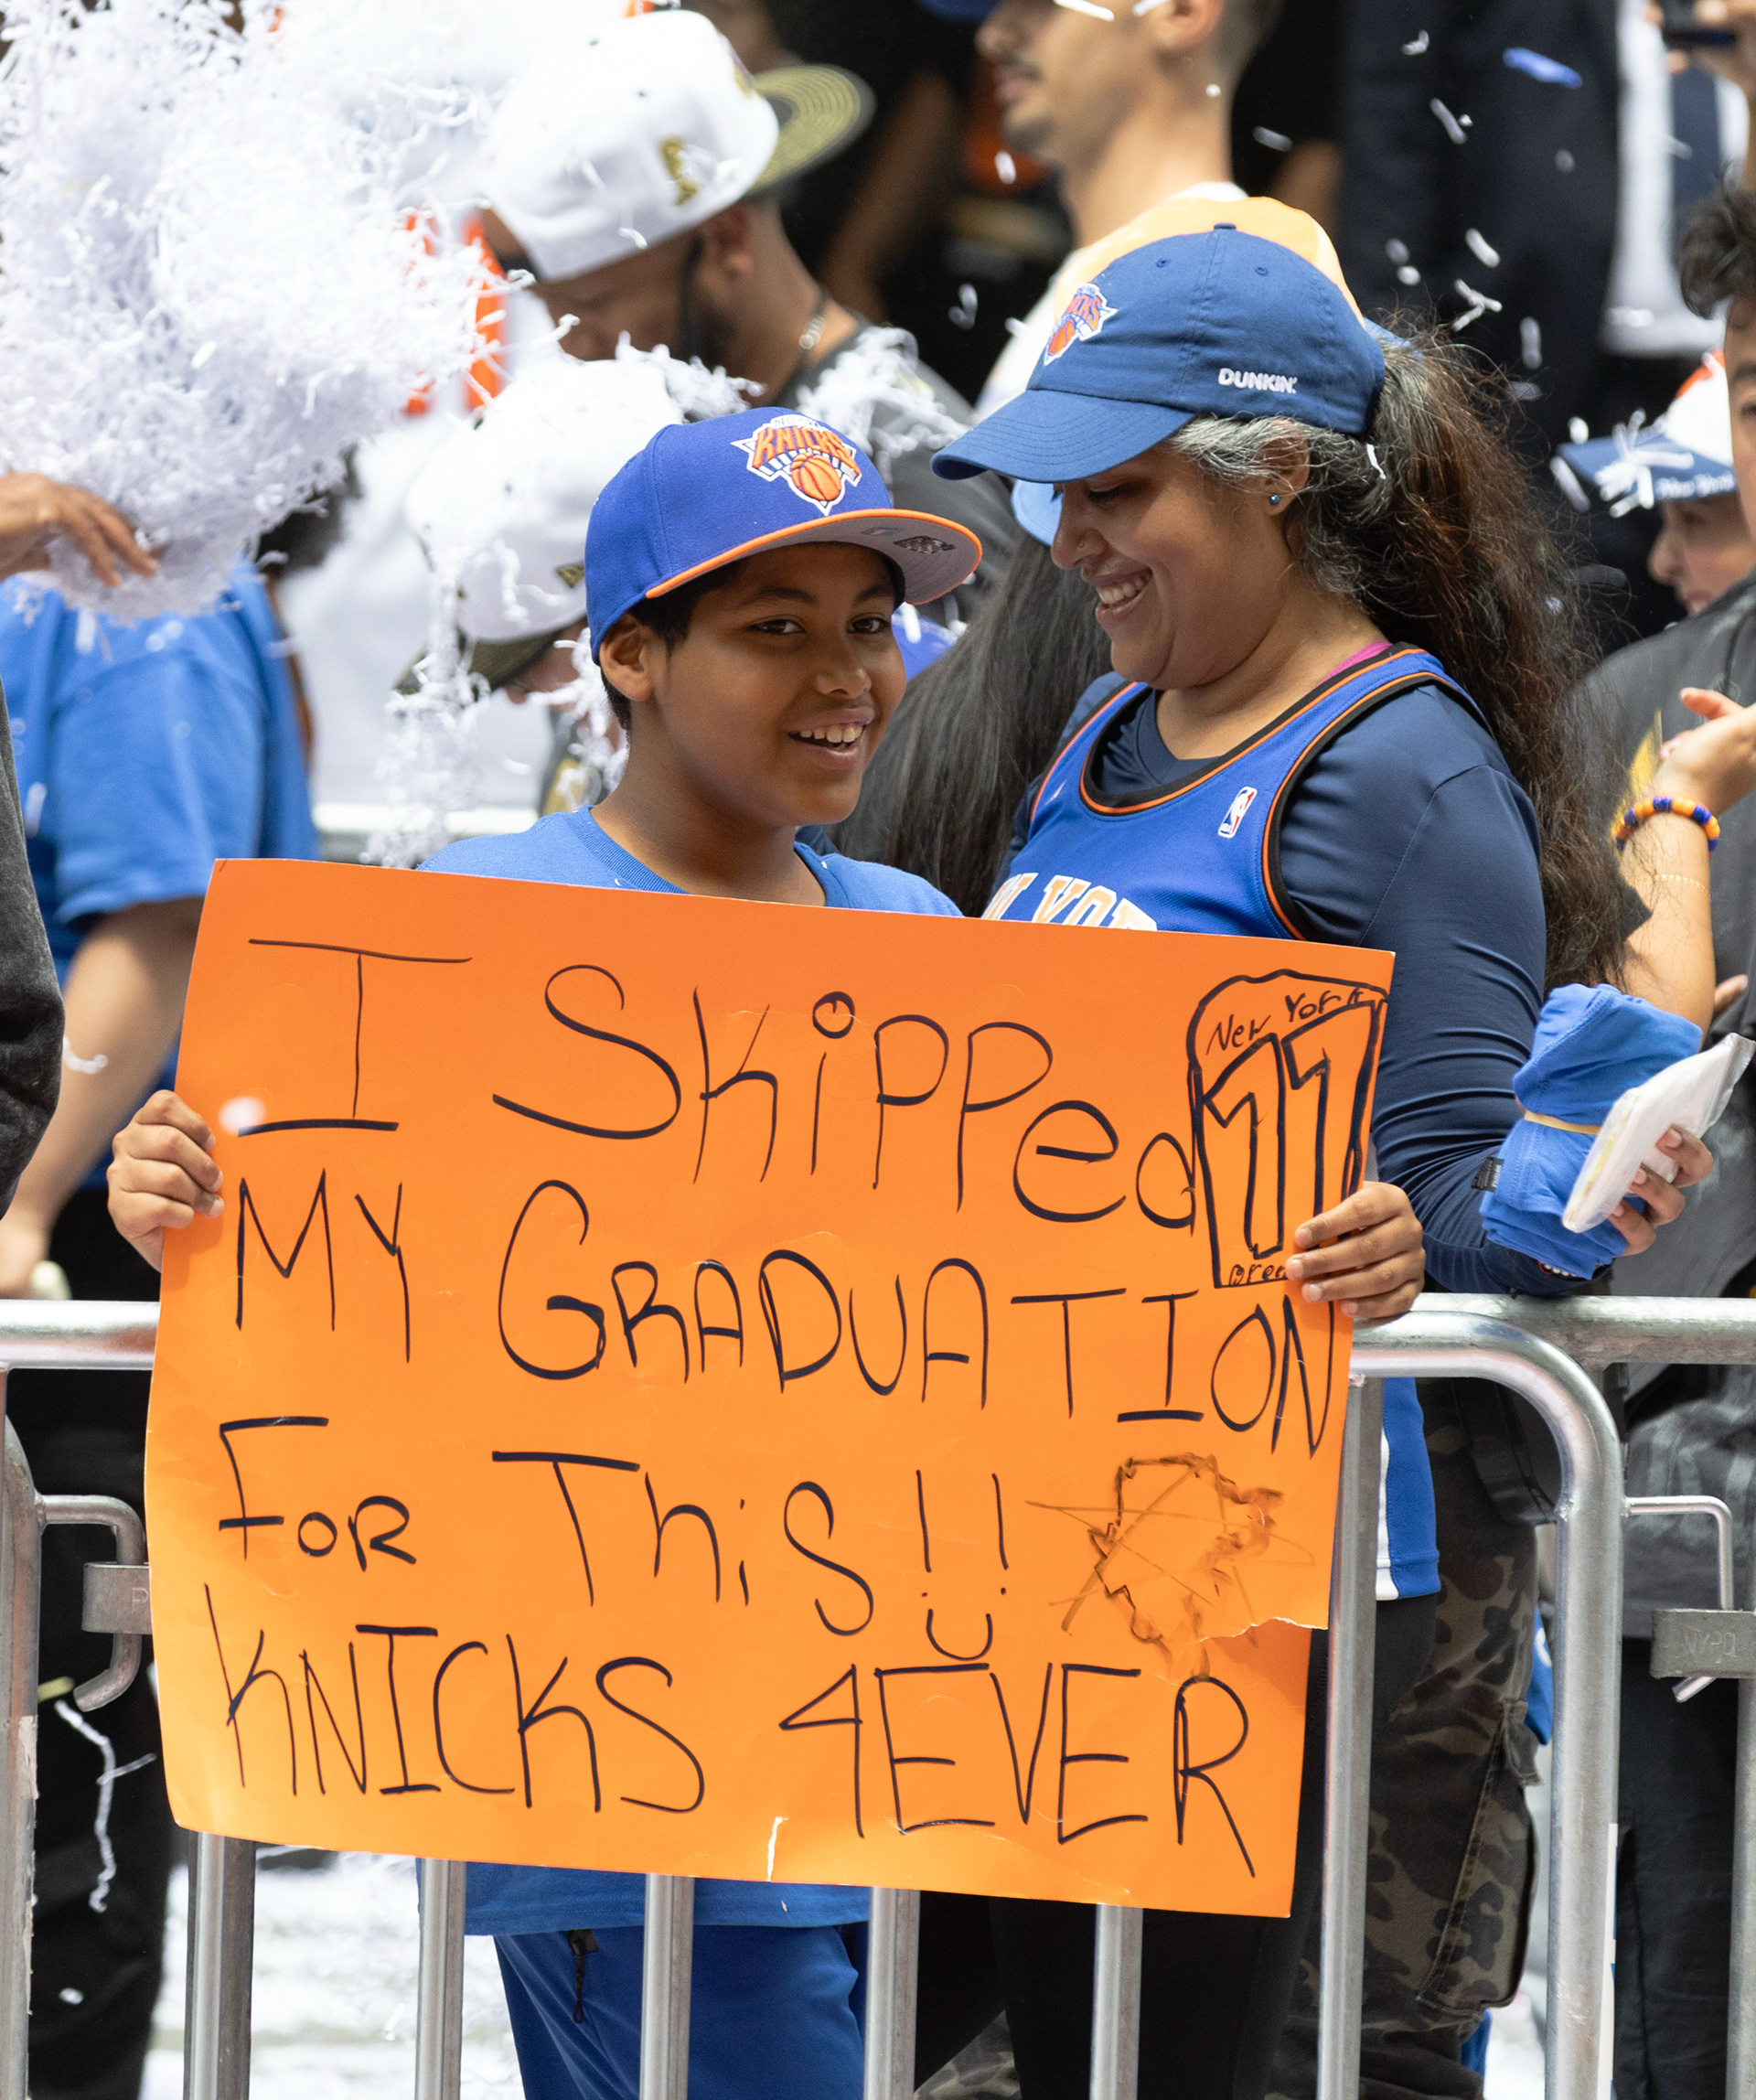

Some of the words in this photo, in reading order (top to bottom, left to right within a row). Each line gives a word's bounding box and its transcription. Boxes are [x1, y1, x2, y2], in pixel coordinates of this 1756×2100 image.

[752, 426, 861, 475] KNICKS
[240, 939, 471, 1136] I
[493, 965, 1195, 1235] Skipped
[1206, 1014, 1271, 1055] New
[236, 1170, 410, 1362] MY
[498, 1180, 1333, 1459] GRADUATION
[205, 1584, 704, 1812] KNICKS
[779, 1663, 1254, 1877] 4EVER
